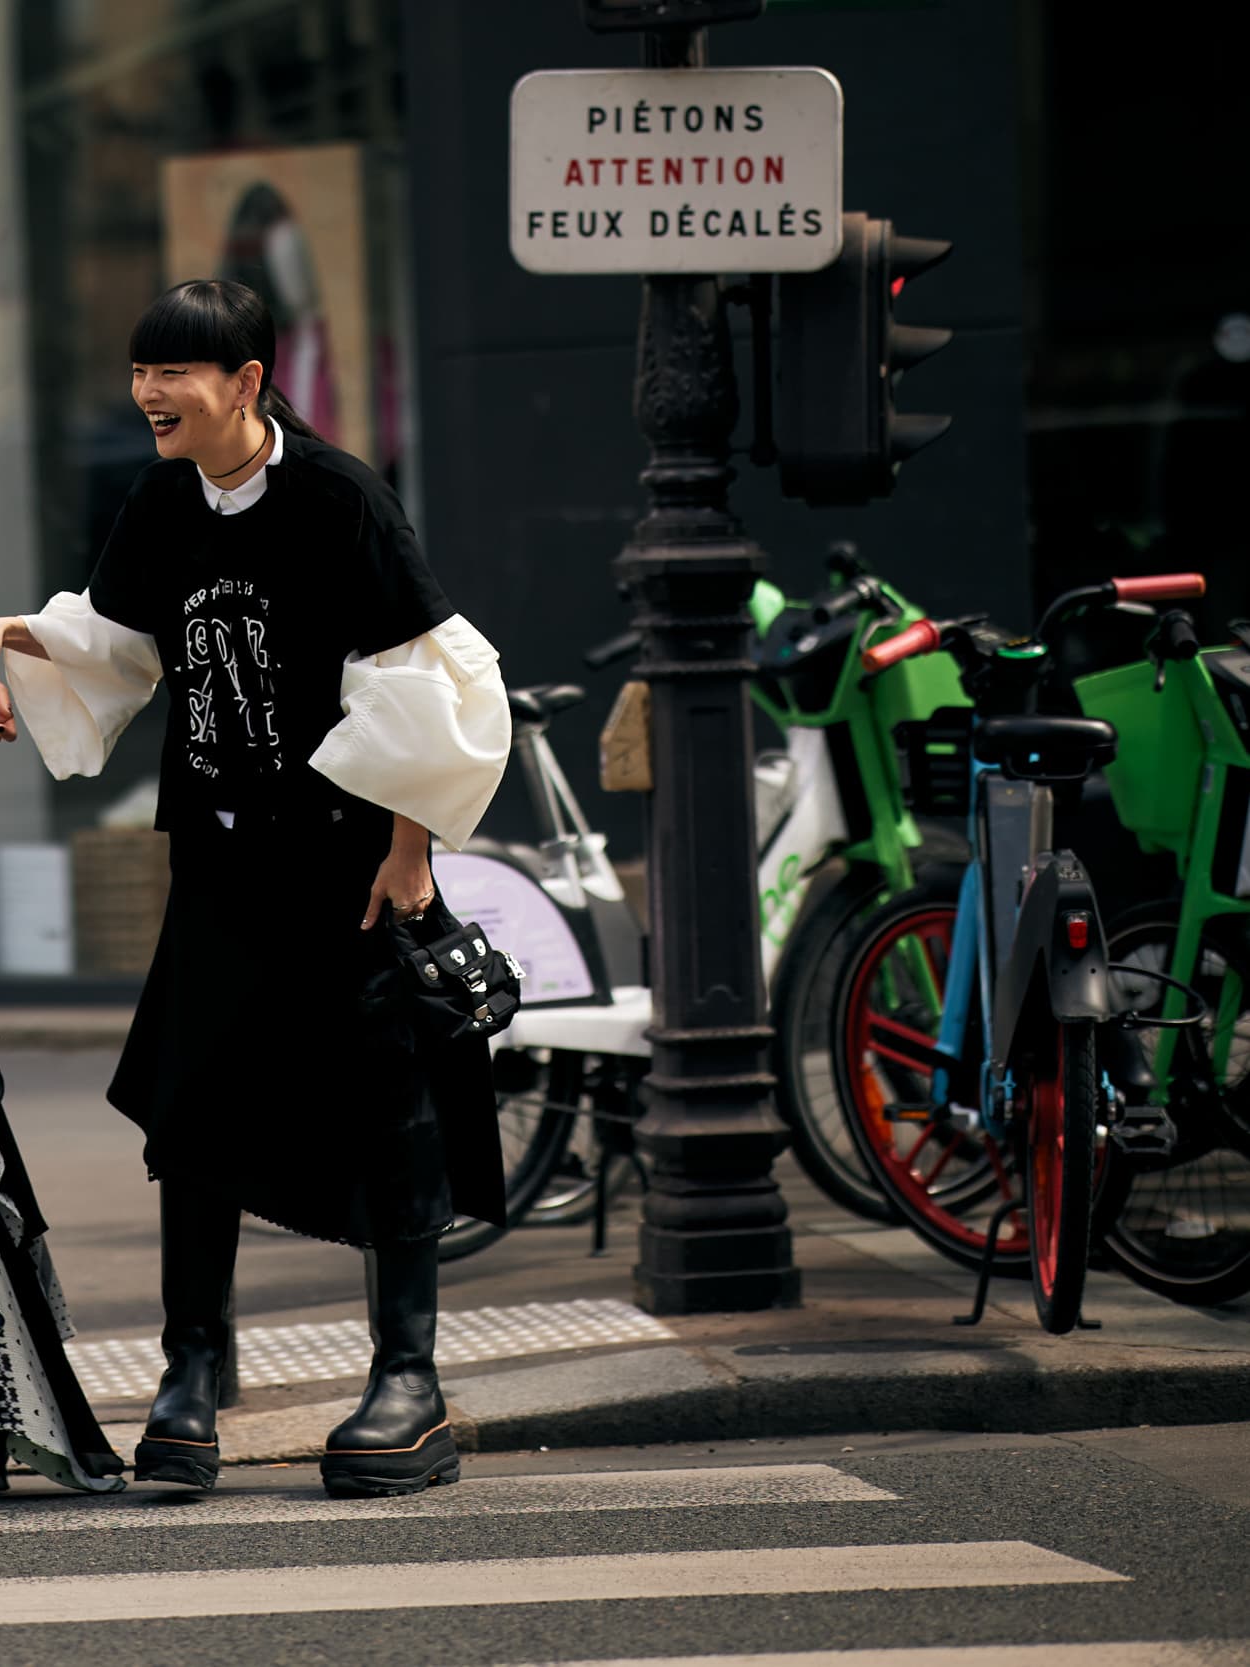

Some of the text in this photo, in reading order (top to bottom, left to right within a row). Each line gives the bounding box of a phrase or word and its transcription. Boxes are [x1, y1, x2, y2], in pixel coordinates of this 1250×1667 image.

[587, 100, 764, 134] PIÉTONS
[564, 156, 785, 187] ATTENTION
[528, 203, 824, 239] FEUX DÉCALÉS
